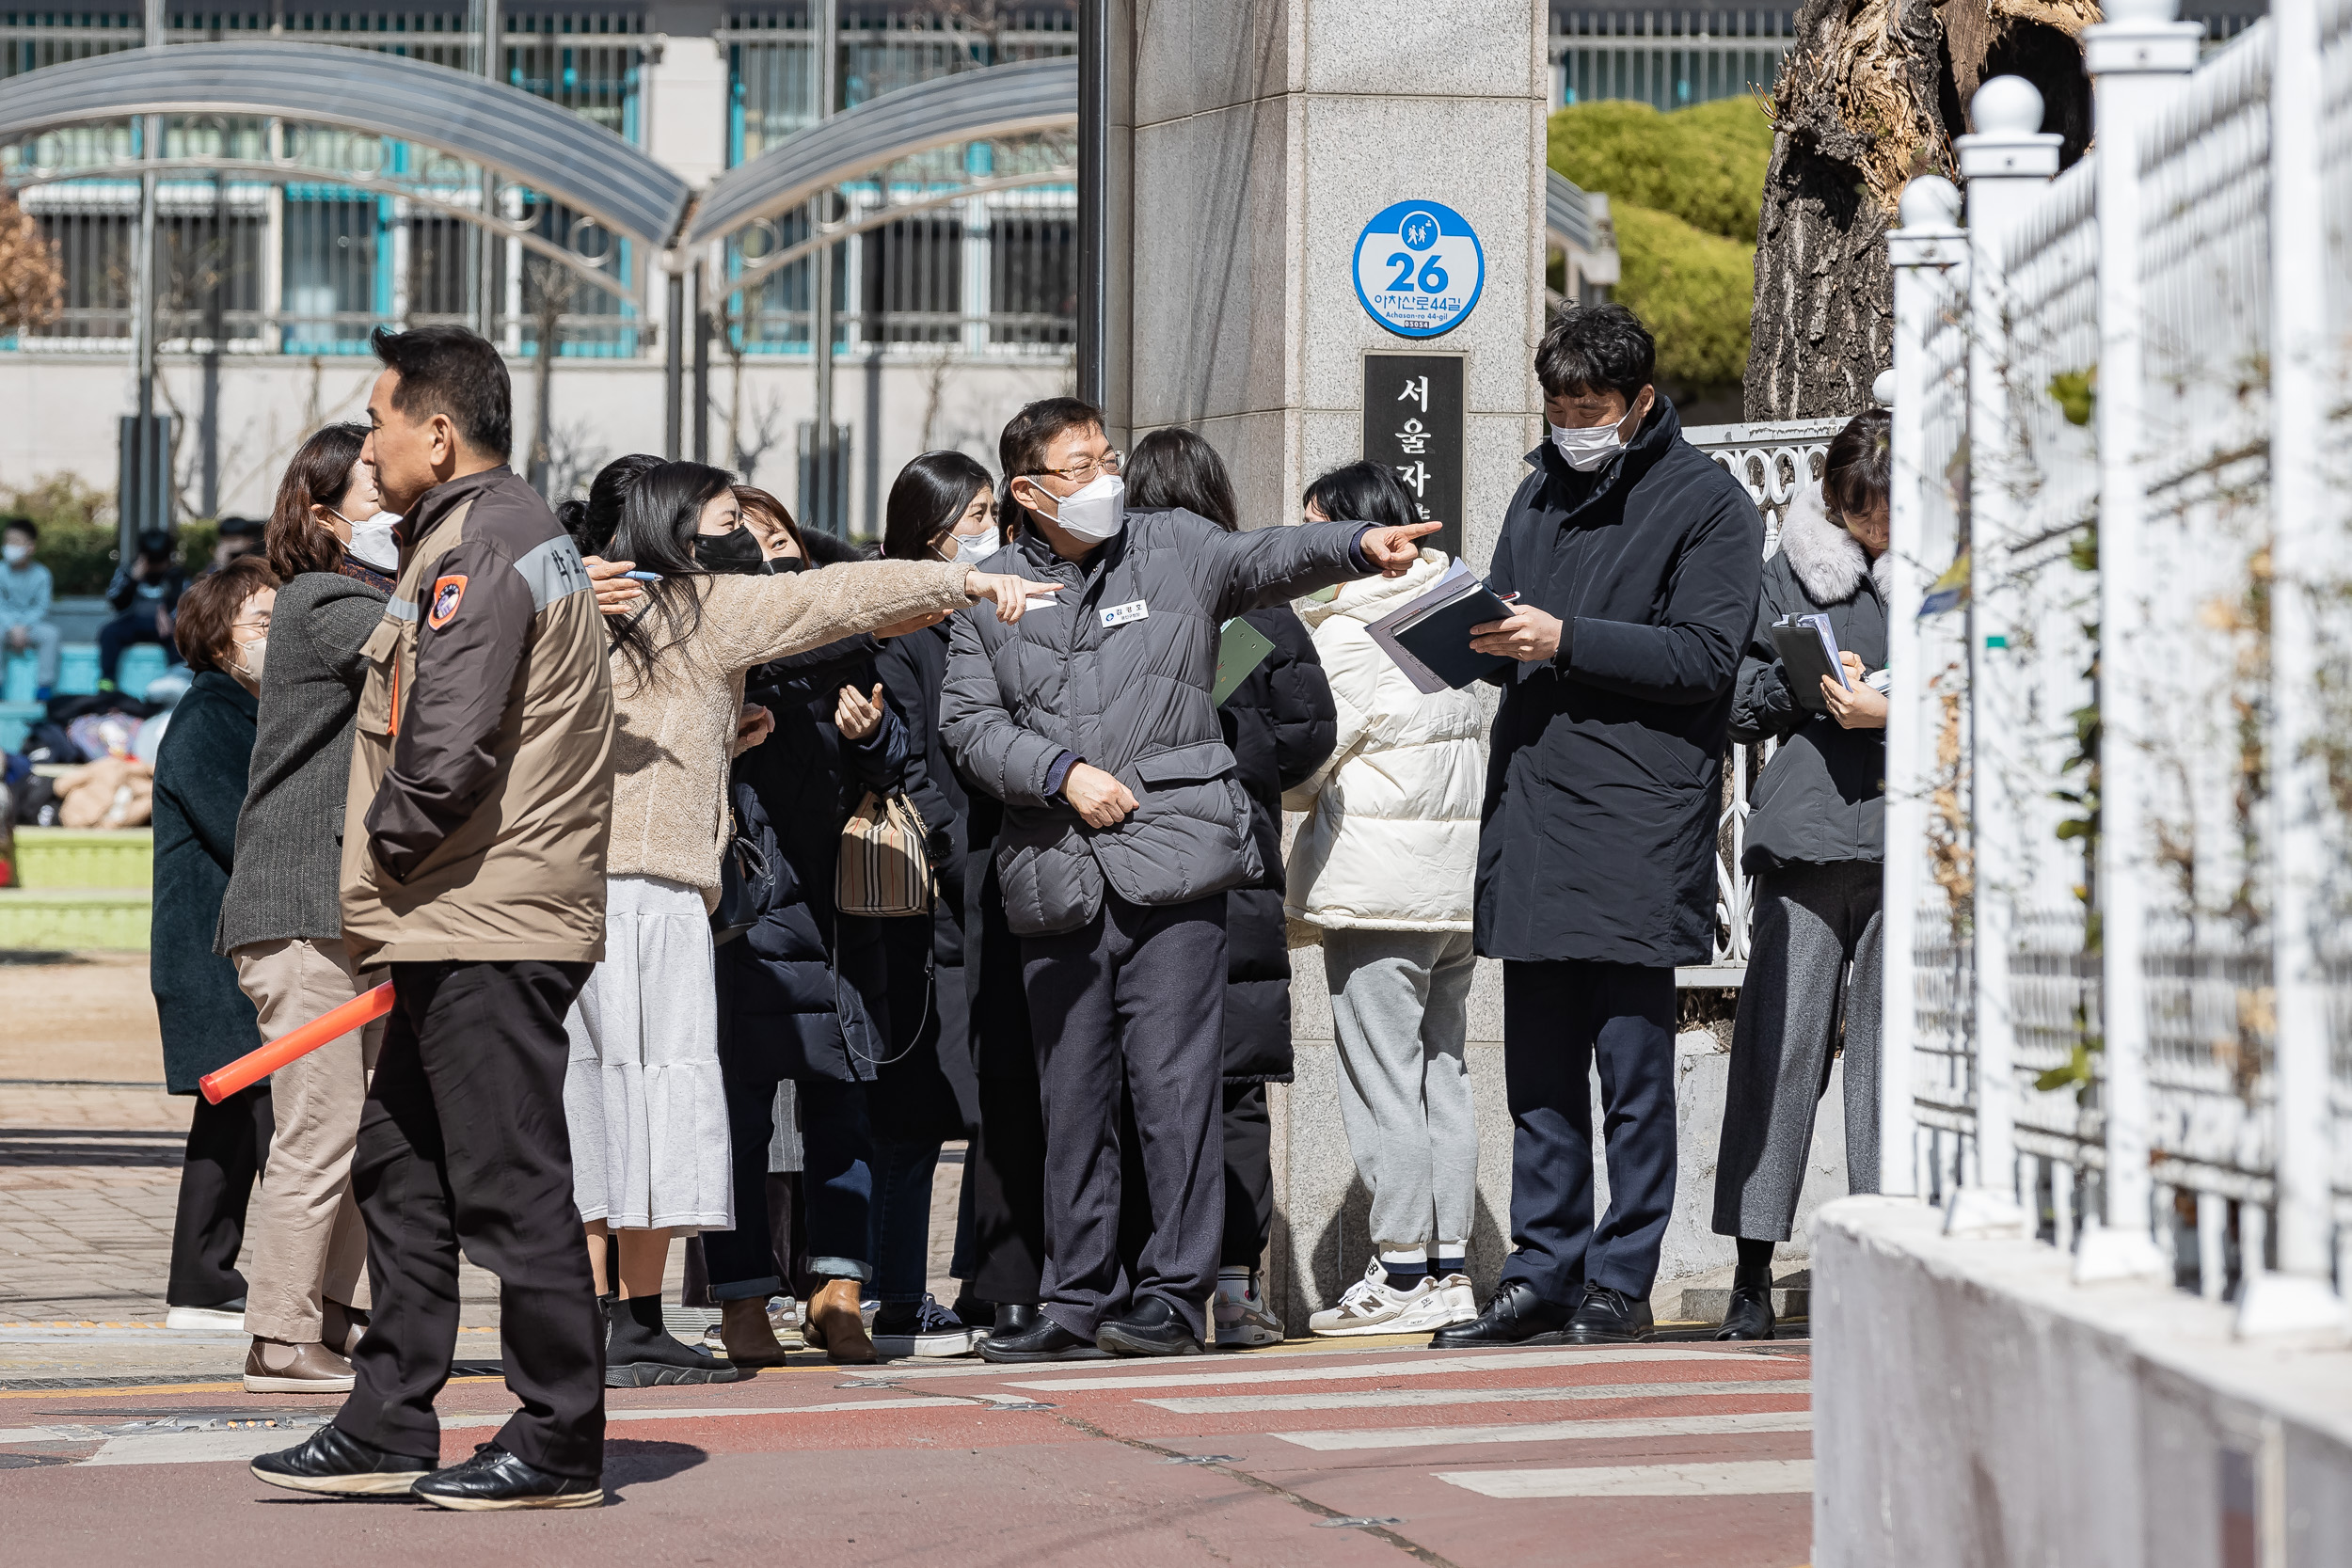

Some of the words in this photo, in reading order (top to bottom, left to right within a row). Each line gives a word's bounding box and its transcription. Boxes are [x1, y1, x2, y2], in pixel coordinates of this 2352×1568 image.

[1385, 252, 1449, 294] 26
[1375, 294, 1460, 311] 아차산로44길
[1386, 311, 1425, 320] Achasan-ro
[1427, 312, 1448, 322] 44-gil
